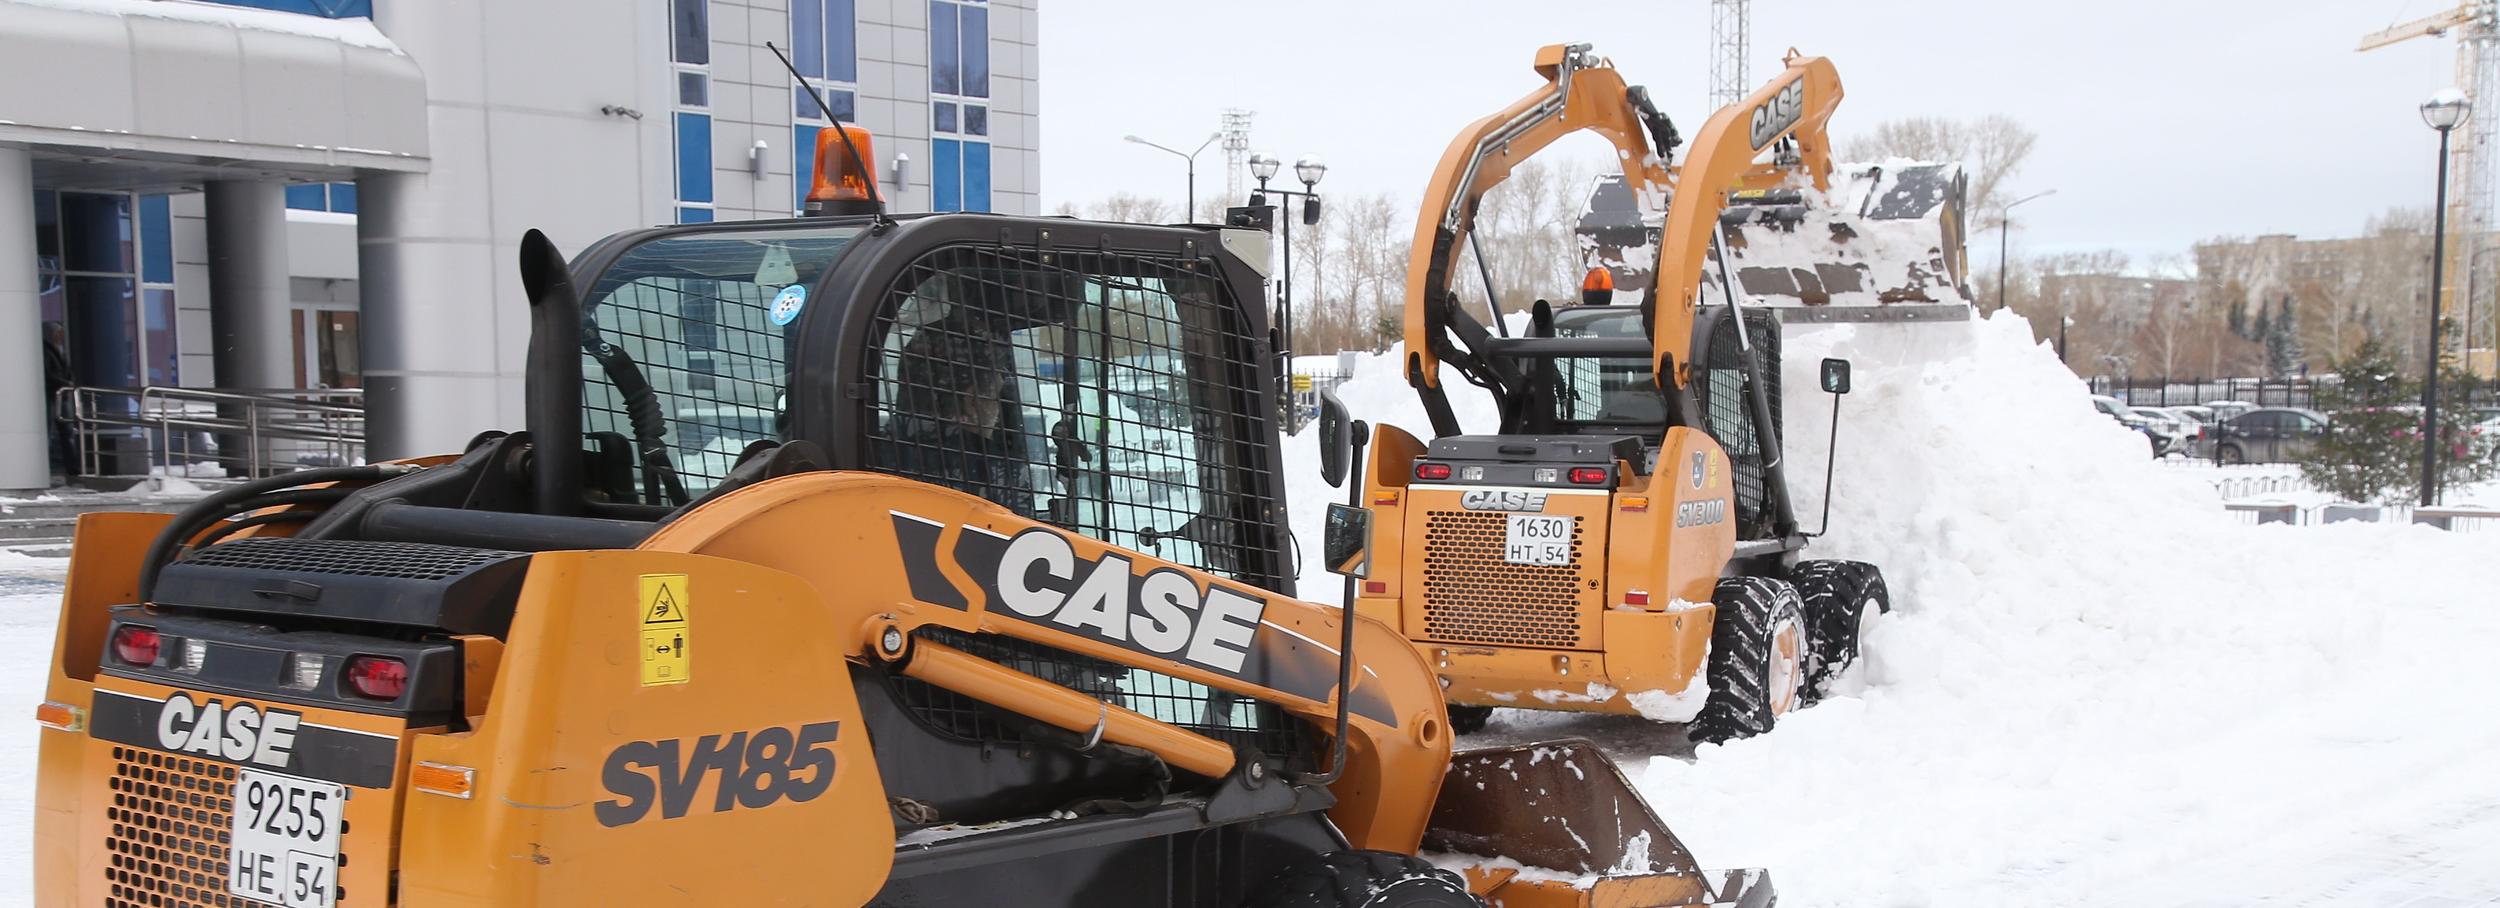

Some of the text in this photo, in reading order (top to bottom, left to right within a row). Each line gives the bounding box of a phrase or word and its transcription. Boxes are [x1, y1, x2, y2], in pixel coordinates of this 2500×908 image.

[1751, 77, 1802, 151] CASE
[1461, 491, 1547, 512] CASE
[1516, 518, 1563, 538] 1630
[1677, 498, 1725, 528] SV300
[1545, 546, 1564, 561] 54
[997, 531, 1265, 673] CASE
[158, 695, 301, 767] CASE
[594, 720, 840, 828] SV185
[249, 780, 328, 842] 9255
[294, 862, 325, 906] 54
